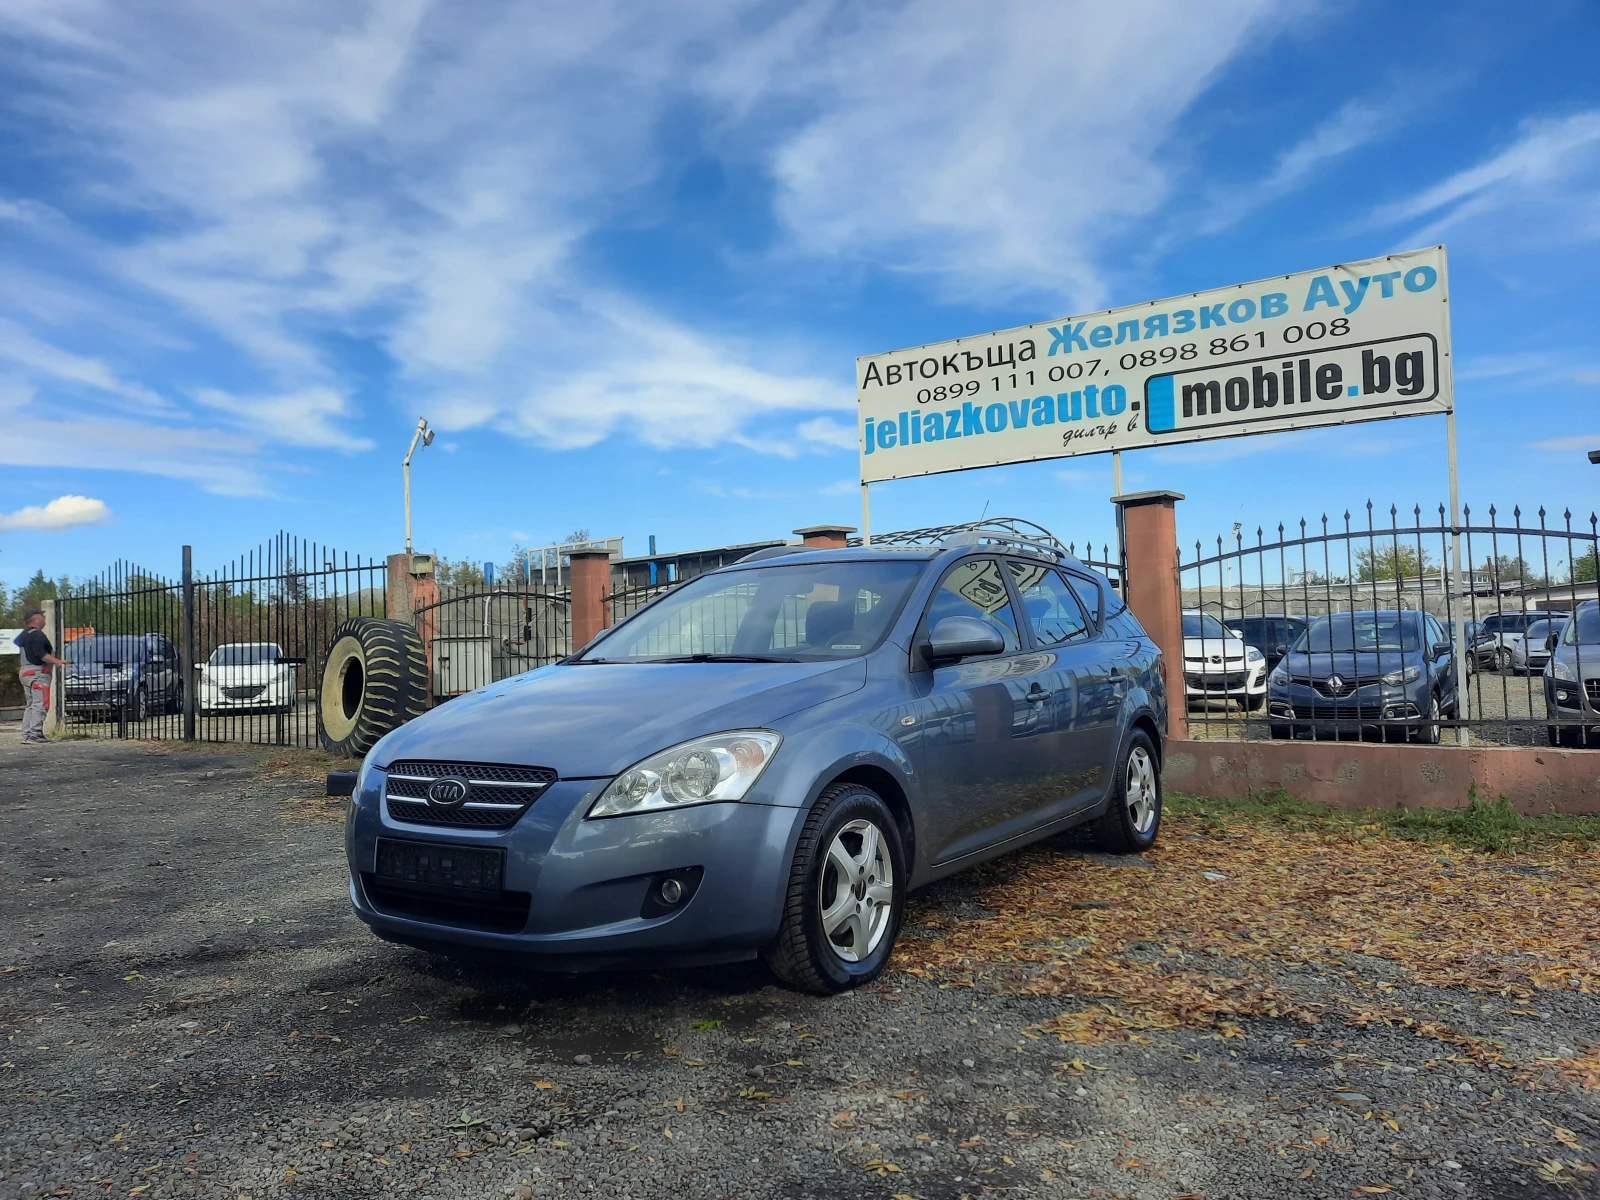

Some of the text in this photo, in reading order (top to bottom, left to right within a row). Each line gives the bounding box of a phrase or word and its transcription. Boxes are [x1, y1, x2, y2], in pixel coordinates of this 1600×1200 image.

[862, 265, 1438, 390] Автокъща Желязков Ауто
[916, 317, 1351, 404] 0899 111 007, 0898 861 008
[864, 348, 1425, 456] jeliazkovauto. mobile.bg
[1062, 412, 1140, 448] дилър в
[433, 785, 458, 800] KIA
